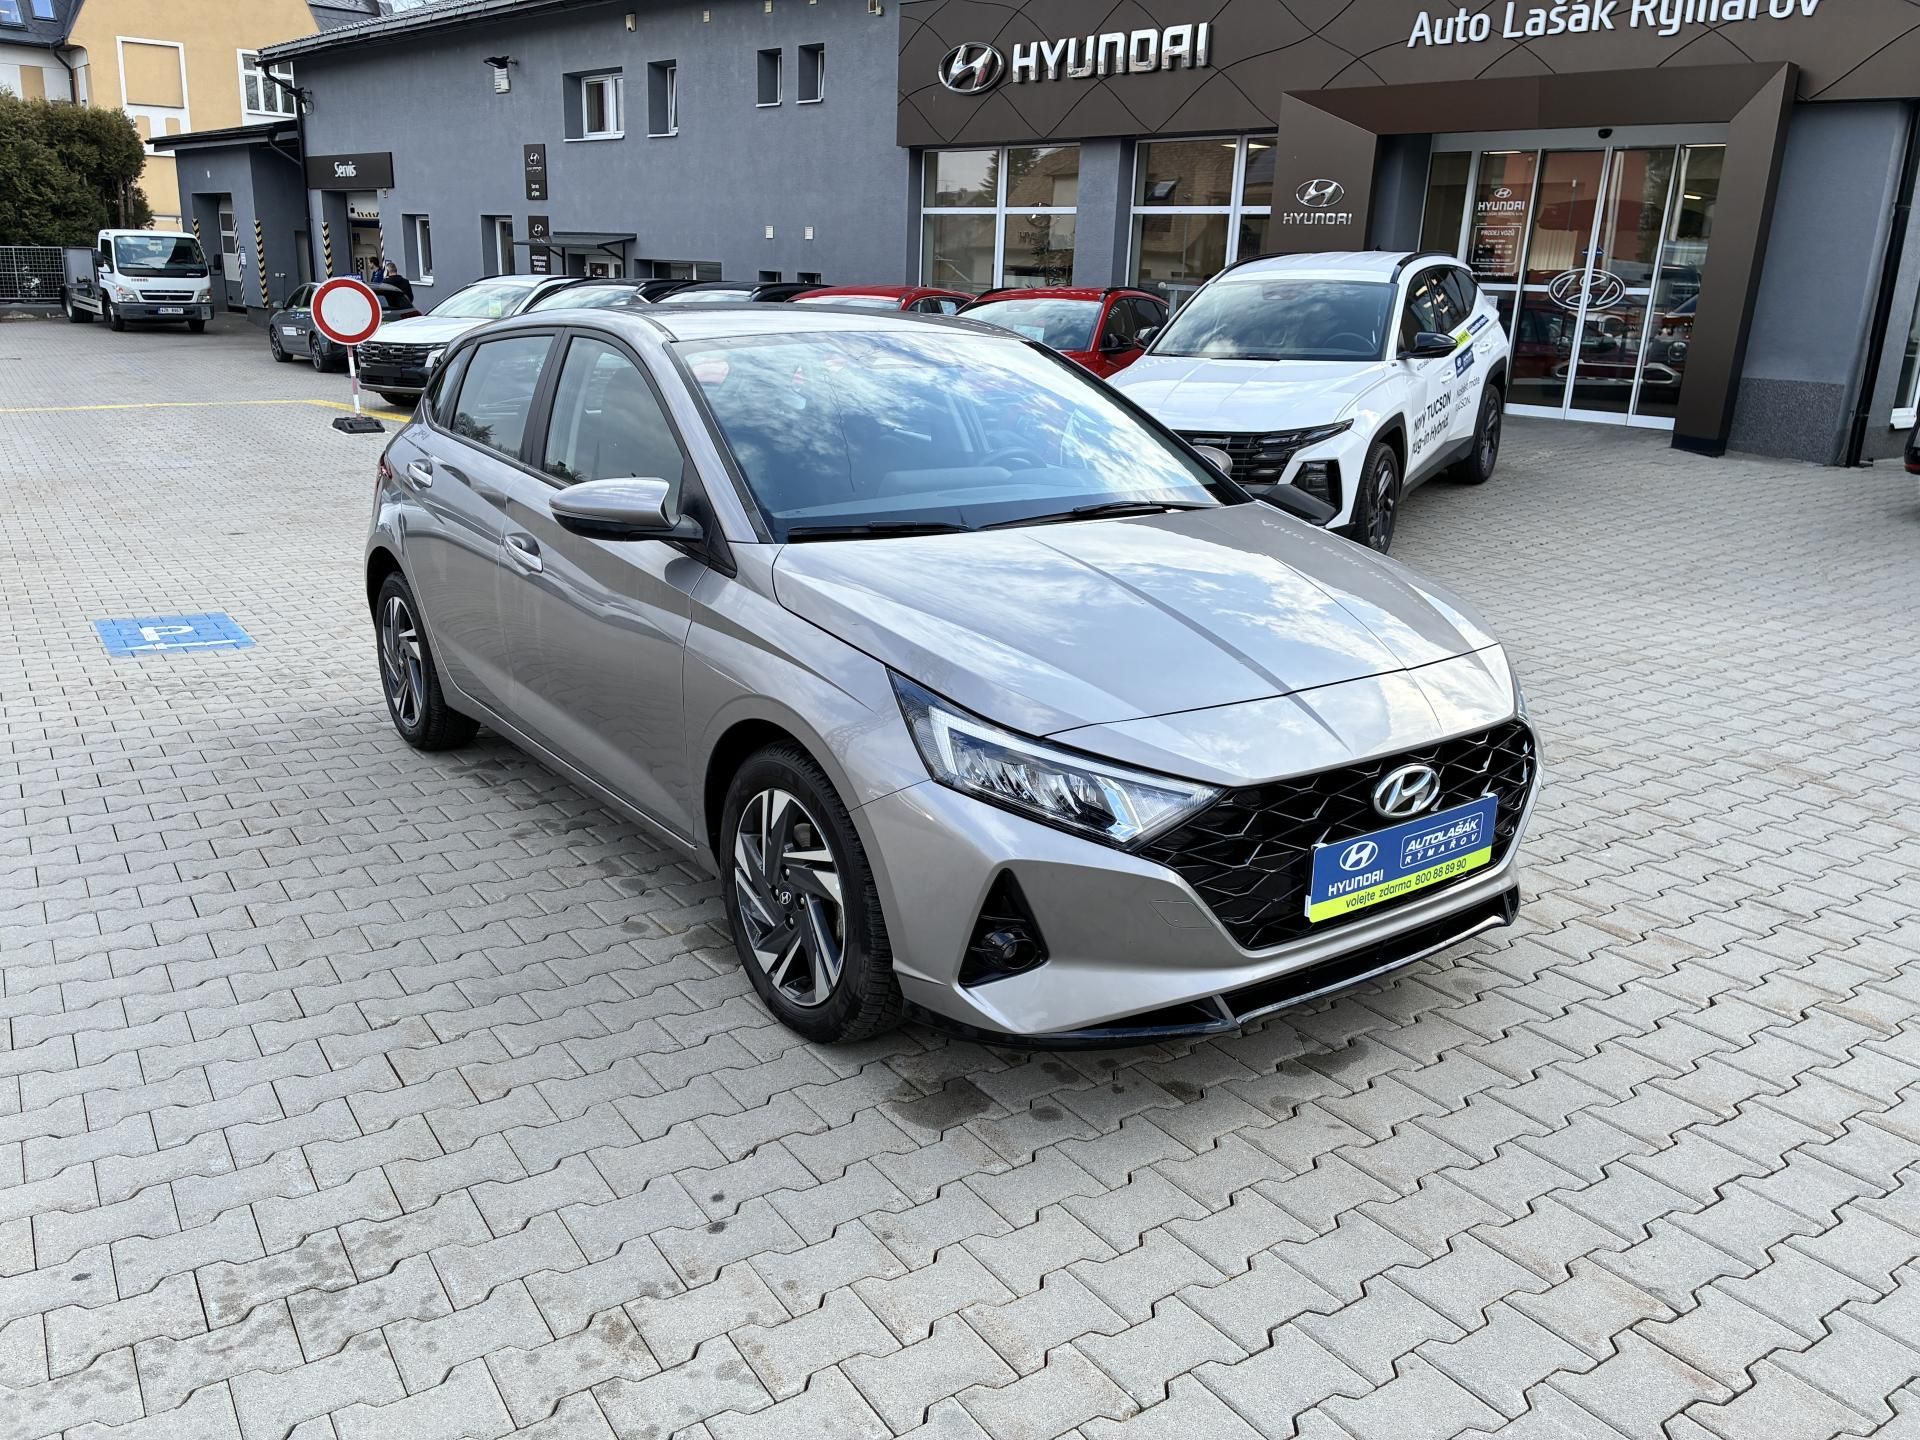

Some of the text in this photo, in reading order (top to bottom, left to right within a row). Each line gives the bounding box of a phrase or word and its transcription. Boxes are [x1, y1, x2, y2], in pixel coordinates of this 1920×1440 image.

[1406, 7, 1491, 48] Auto
[1502, 0, 1619, 39] Lašák
[1012, 22, 1210, 83] HYUNDAI
[333, 160, 357, 178] Servis
[1282, 212, 1353, 225] HYUNDAI
[1477, 201, 1525, 211] HYUNDAI
[1427, 389, 1451, 421] TUCSON
[1405, 819, 1478, 852] AUTOLAŠÁK
[1328, 869, 1384, 897] HYUNDAI
[1345, 858, 1467, 908] volejte zdarma 800 88 89 90
